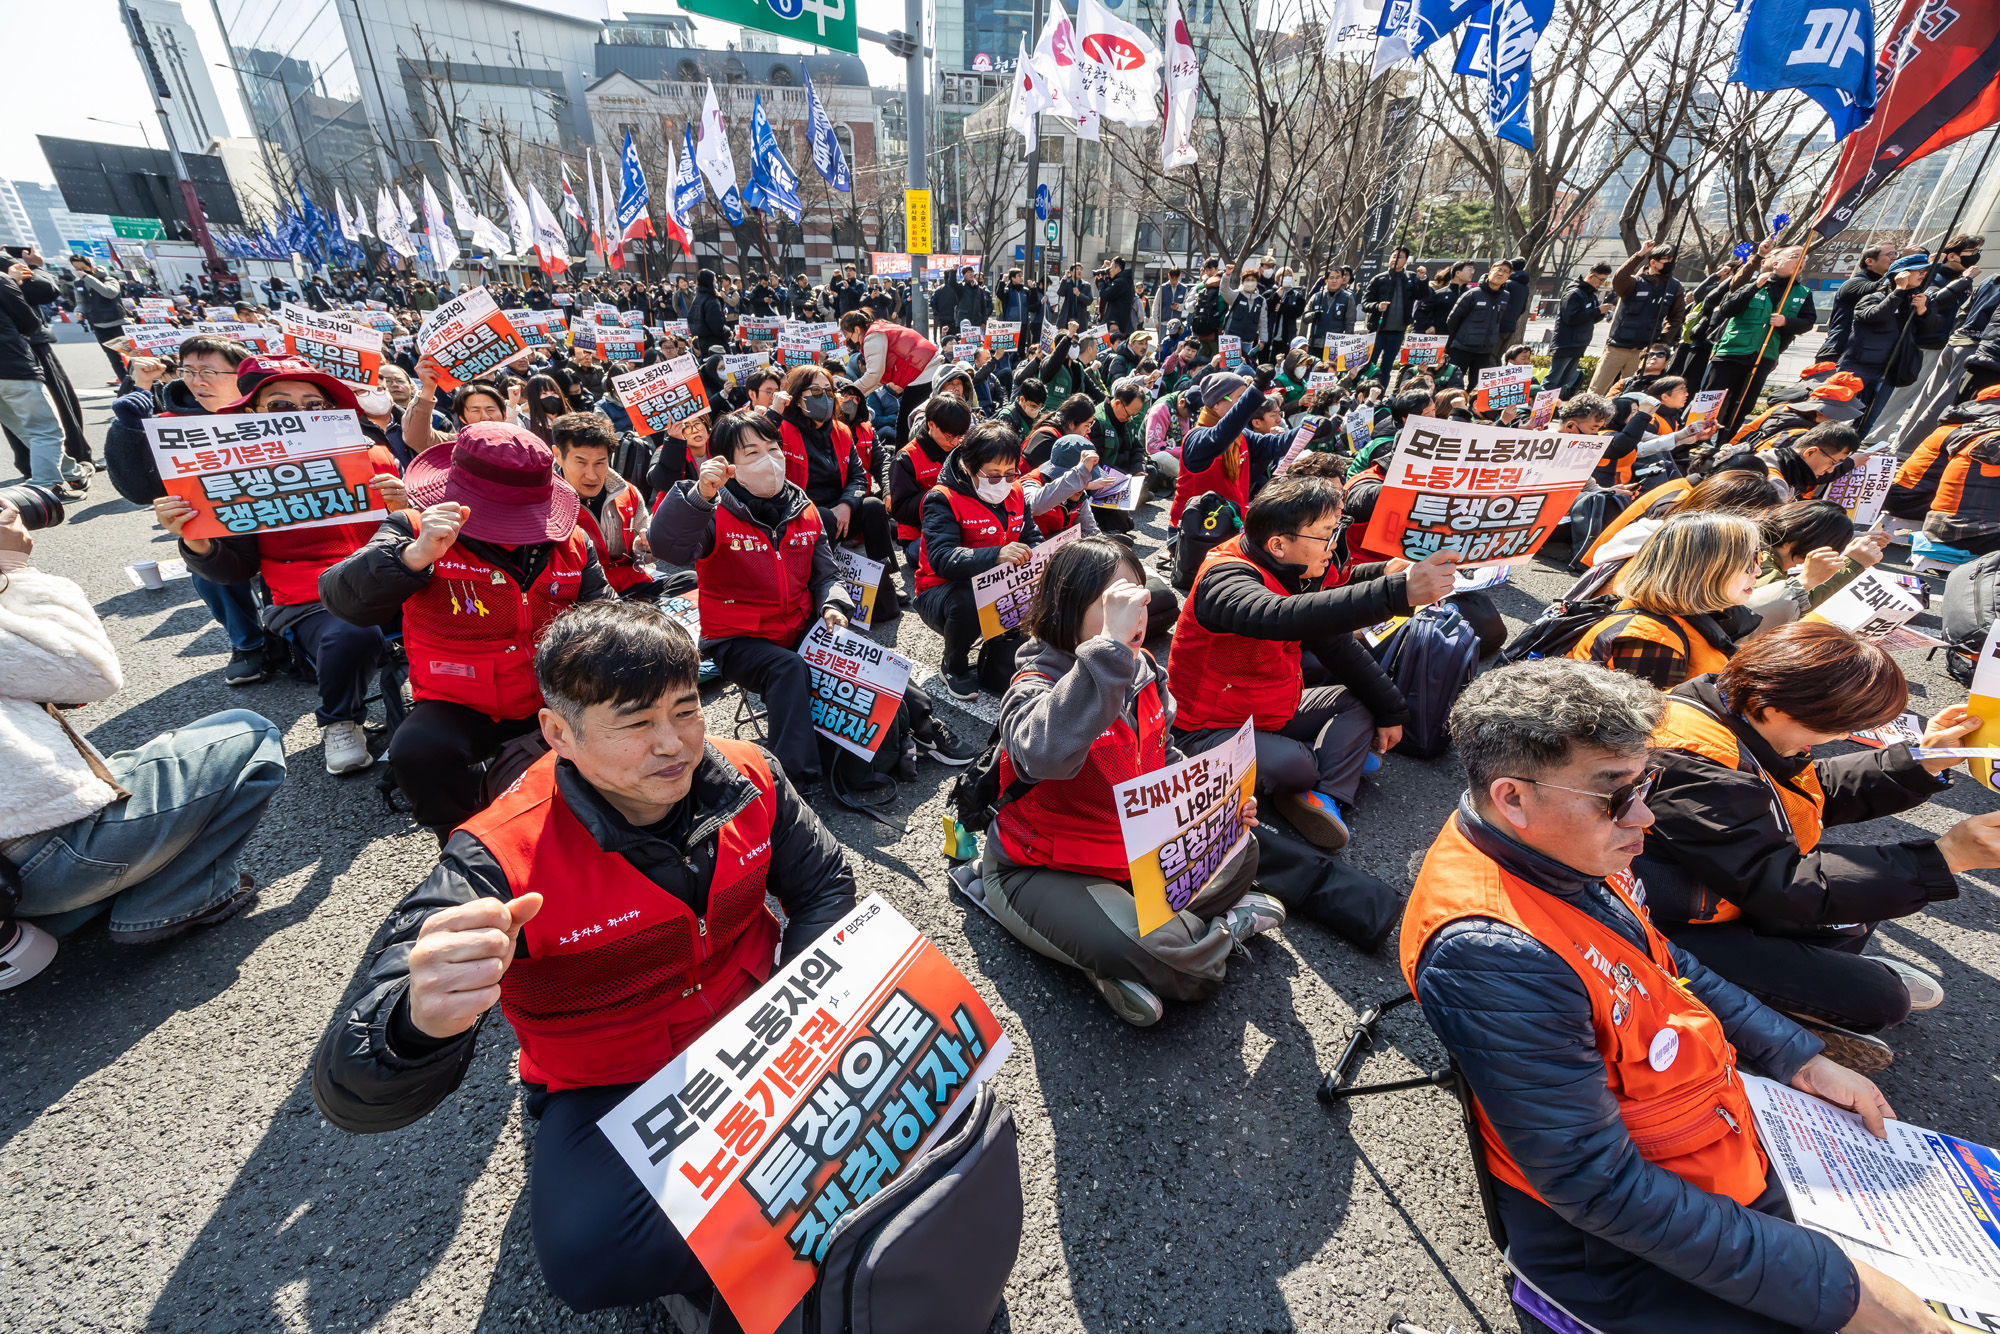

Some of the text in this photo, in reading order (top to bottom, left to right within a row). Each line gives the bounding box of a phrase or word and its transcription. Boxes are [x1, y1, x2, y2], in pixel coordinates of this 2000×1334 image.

[152, 331, 181, 339] 노동자의
[199, 324, 245, 333] 모든 노동자의
[285, 308, 303, 324] 모든
[306, 314, 352, 334] 노동자의
[288, 323, 337, 342] 노동기본권
[420, 327, 431, 346] 모든
[430, 300, 466, 332] 노동자의
[597, 326, 608, 335] 모든
[294, 337, 360, 366] 투쟁으로
[433, 323, 499, 368] 투쟁으로
[449, 334, 519, 382] 쟁취하자!
[604, 343, 636, 351] 투쟁으로
[606, 351, 641, 360] 쟁취하자!
[784, 350, 812, 359] 투쟁으로
[1408, 349, 1438, 357] 투쟁으로
[618, 379, 637, 393] 모든
[636, 363, 673, 385] 노동자의
[1481, 366, 1523, 381] 모든 노동자의
[1483, 376, 1516, 388] 노동기본권
[1488, 382, 1525, 398] 투쟁으로
[625, 379, 668, 404] 노동기본권
[637, 383, 692, 416] 투쟁으로
[1488, 393, 1526, 410] 쟁취하자!
[646, 395, 703, 431] 쟁취하자!
[157, 427, 210, 450] 모든
[214, 415, 306, 444] 노동자의
[1403, 428, 1462, 461] 모든
[1464, 437, 1562, 463] 노동자의
[171, 440, 289, 474] 노동기본권
[199, 457, 343, 502] 투쟁으로
[1401, 464, 1524, 491] 노동기본권
[215, 484, 370, 533] 쟁취하자!
[1408, 493, 1548, 530] 투쟁으로
[1401, 526, 1546, 564] 쟁취하자!
[803, 645, 860, 678] 노동기본권
[810, 626, 834, 648] 모든
[834, 636, 883, 666] 노동자의
[810, 697, 880, 747] 취하자!
[1123, 759, 1209, 819] 진짜사장
[1175, 763, 1233, 827] 나와라!
[1158, 785, 1242, 880] 원청교섭
[1165, 816, 1244, 912] 쟁취하자!
[559, 924, 602, 945] 노동자는
[632, 903, 881, 1167] 모든 노동자의 민주노총
[678, 1006, 847, 1202] 노동기본권
[738, 987, 939, 1227] 투쟁으로
[783, 1002, 987, 1268] 쟁취하자!
